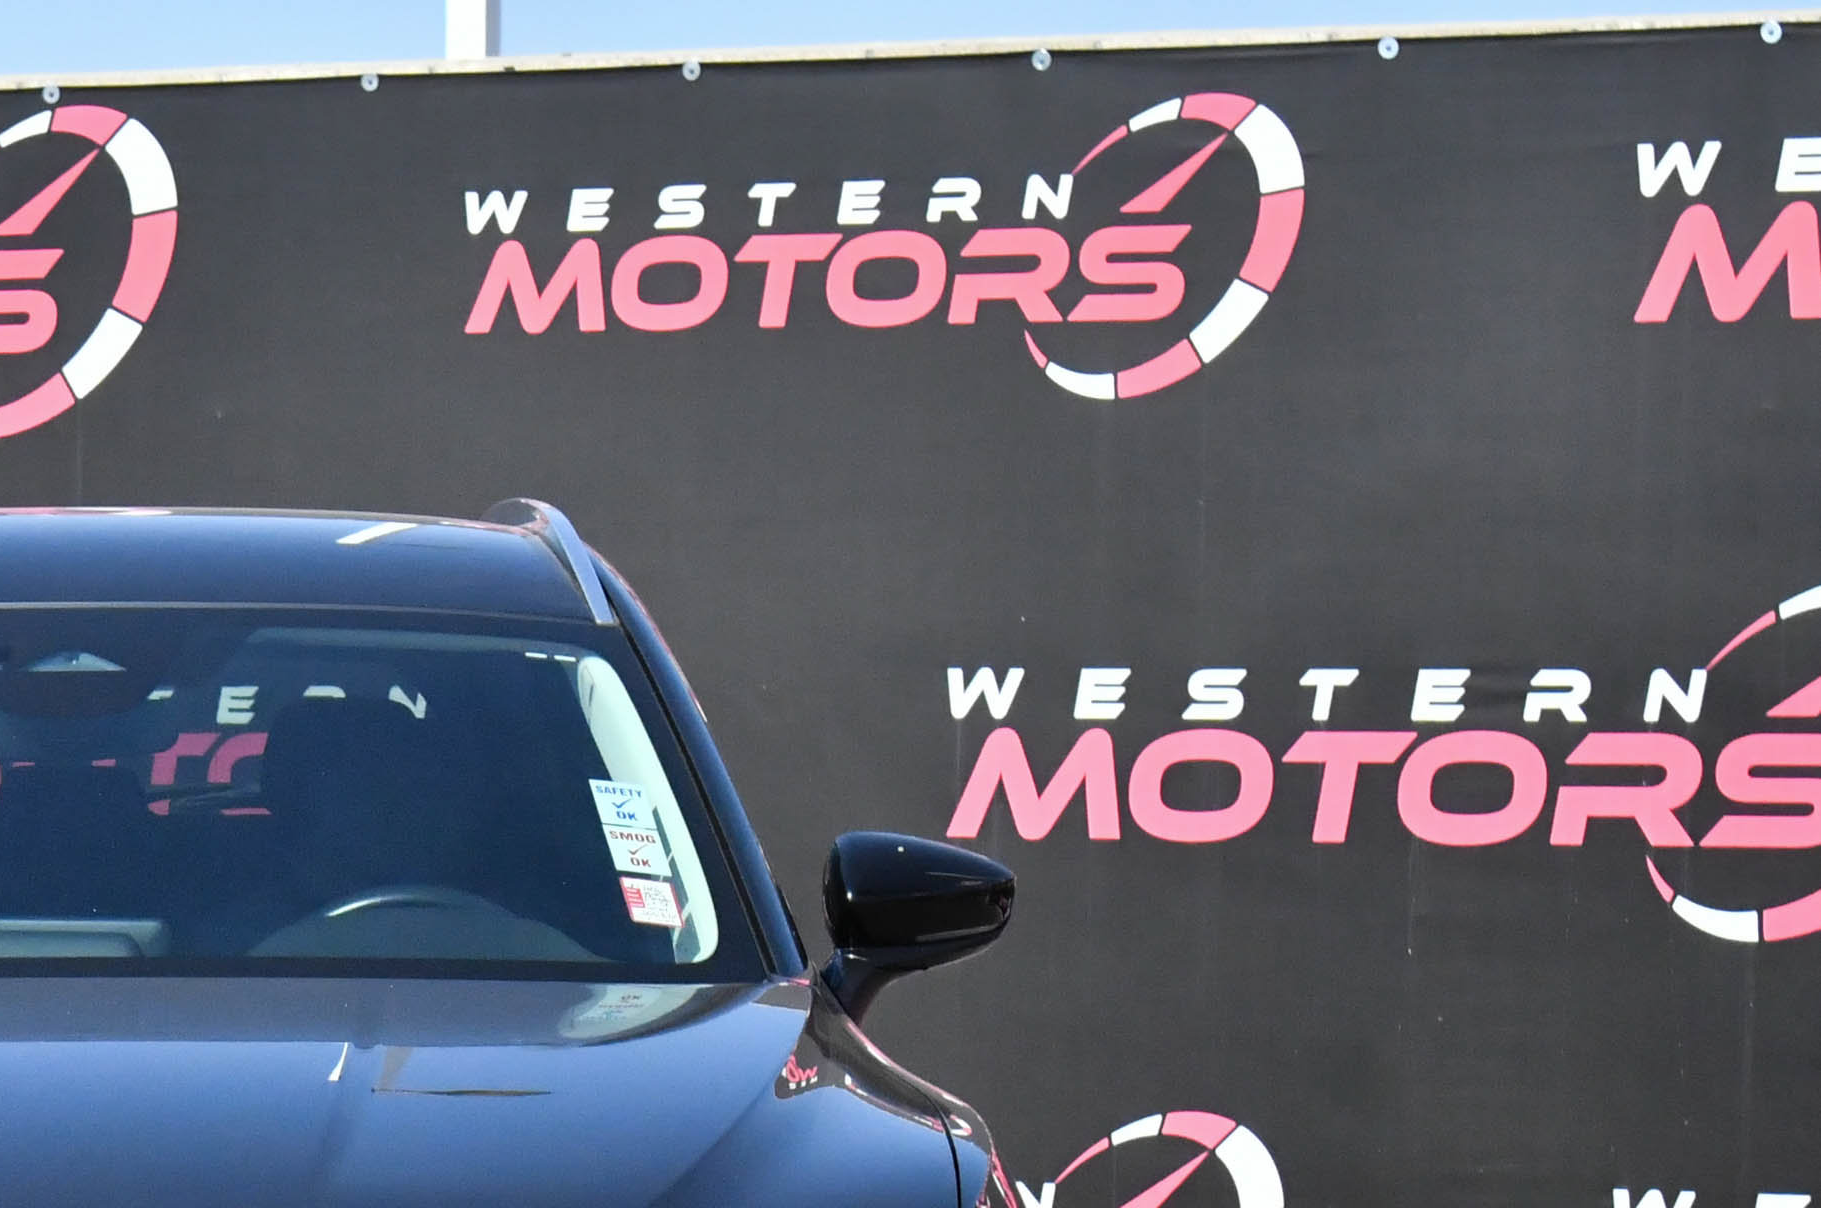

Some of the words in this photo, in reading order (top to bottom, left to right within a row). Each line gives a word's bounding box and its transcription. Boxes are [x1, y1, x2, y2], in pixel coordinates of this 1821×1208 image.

[464, 173, 1074, 235] WESTERN
[464, 223, 1192, 335] MOTORS
[947, 666, 1708, 723] WESTERN
[595, 784, 643, 798] SAFETY
[946, 726, 1821, 849] MOTORS
[615, 810, 639, 822] OK
[608, 830, 657, 844] SMOG
[629, 856, 653, 868] OK
